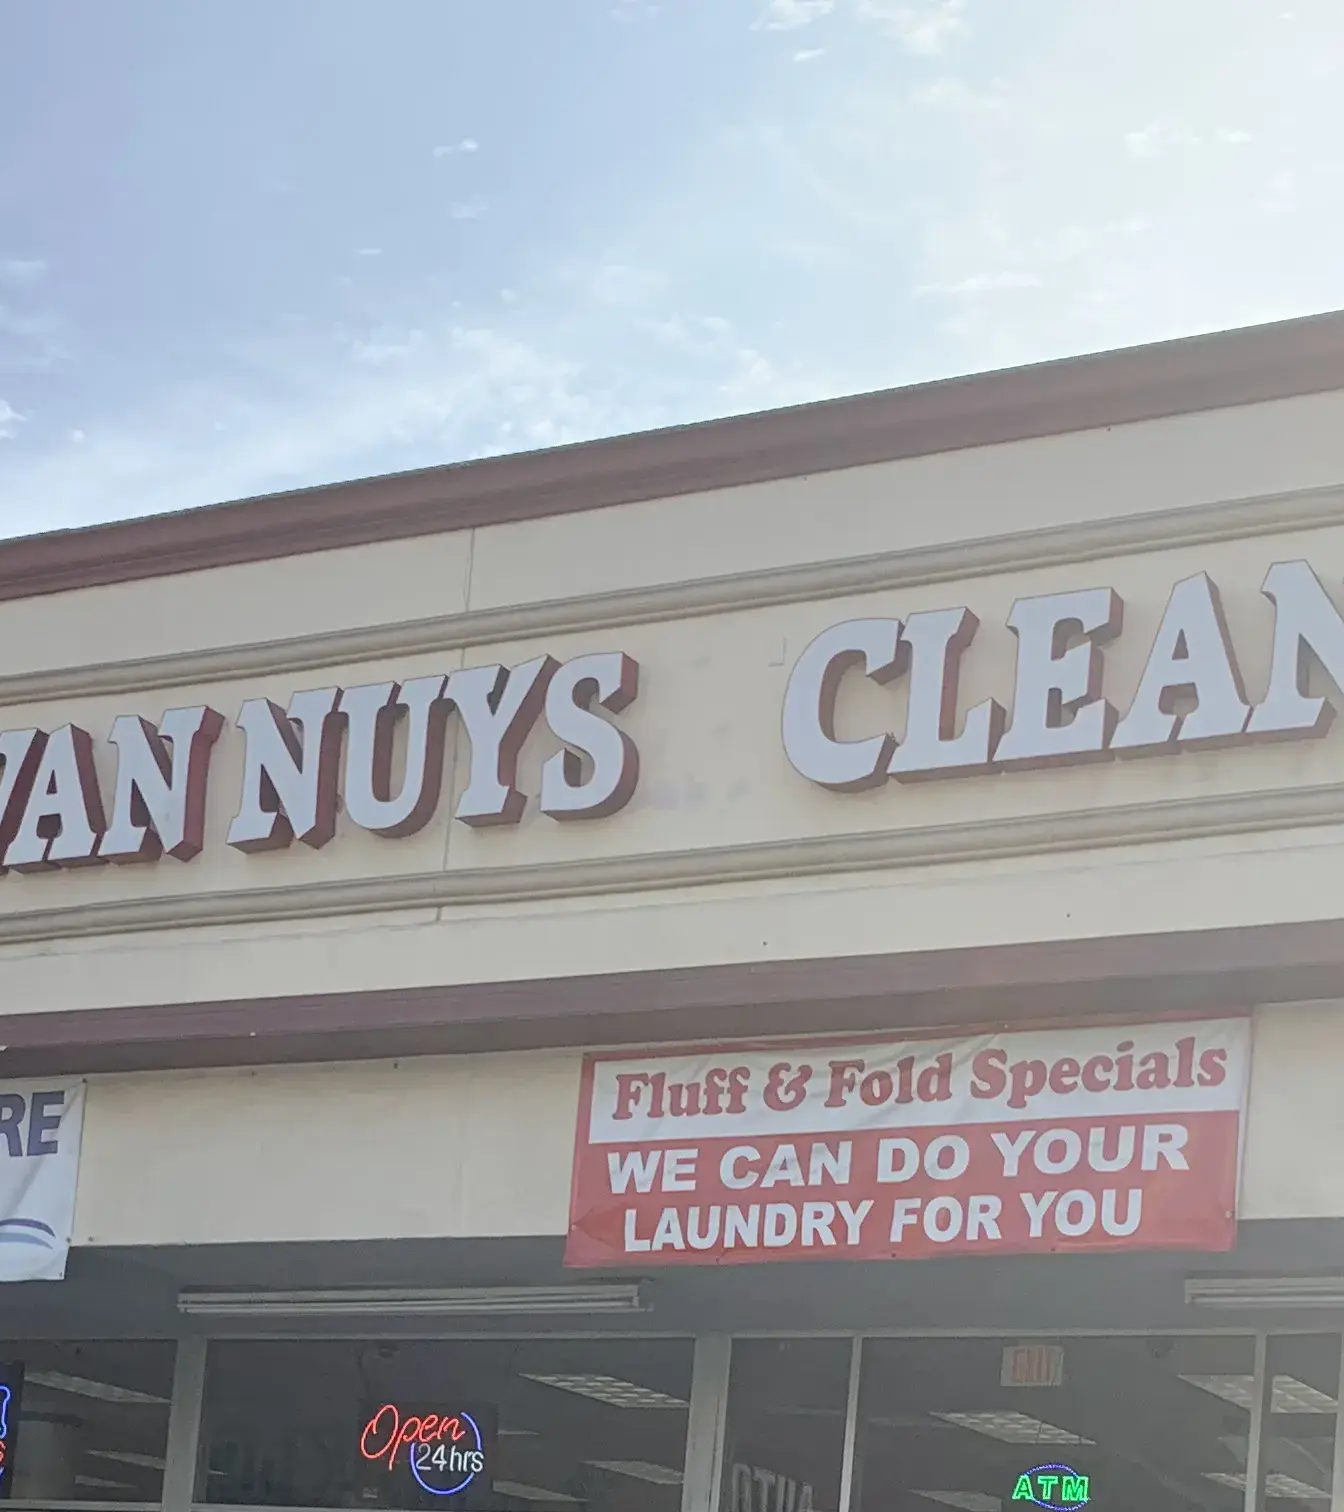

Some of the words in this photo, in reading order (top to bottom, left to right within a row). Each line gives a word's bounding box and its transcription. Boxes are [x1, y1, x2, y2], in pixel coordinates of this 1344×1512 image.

[227, 651, 638, 850] NUYS
[611, 1066, 751, 1121] Fluff
[764, 1062, 813, 1111] &
[825, 1053, 954, 1109] Fold
[971, 1036, 1228, 1109] Specials
[607, 1148, 699, 1193] WE
[719, 1142, 852, 1188] CAN
[877, 1135, 970, 1184] DO
[999, 1123, 1189, 1177] YOUR
[624, 1199, 874, 1251] LAUNDRY
[890, 1195, 1003, 1243] FOR
[1018, 1188, 1143, 1237] YOU
[361, 1404, 465, 1471] Open
[416, 1443, 484, 1472] 24hrs
[1012, 1475, 1089, 1501] ATM
